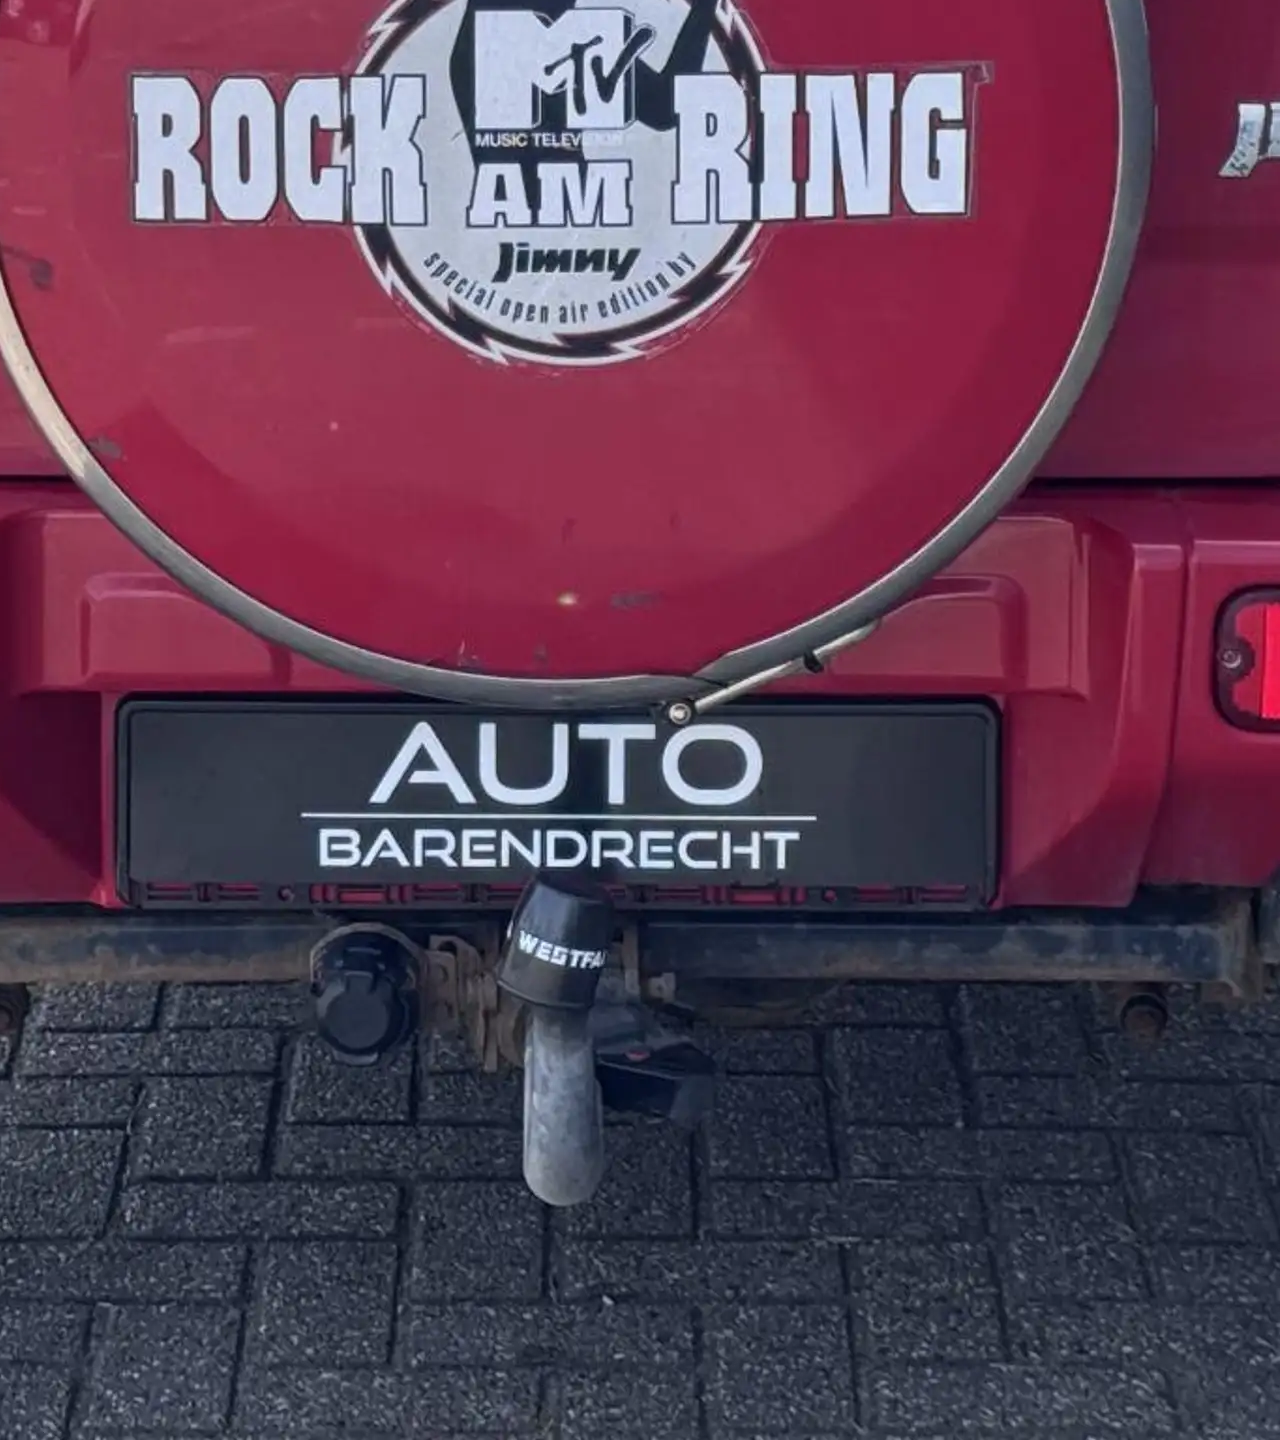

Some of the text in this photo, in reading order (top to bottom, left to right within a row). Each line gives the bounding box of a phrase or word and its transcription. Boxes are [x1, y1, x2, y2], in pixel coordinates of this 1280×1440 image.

[474, 8, 655, 130] MTV
[131, 70, 968, 227] ROCK AM RING
[475, 132, 528, 148] MUSIC
[423, 250, 697, 324] special open air edition by
[492, 242, 641, 283] Jimny
[368, 721, 763, 806] AUTO
[319, 827, 801, 870] BARENDRECHT
